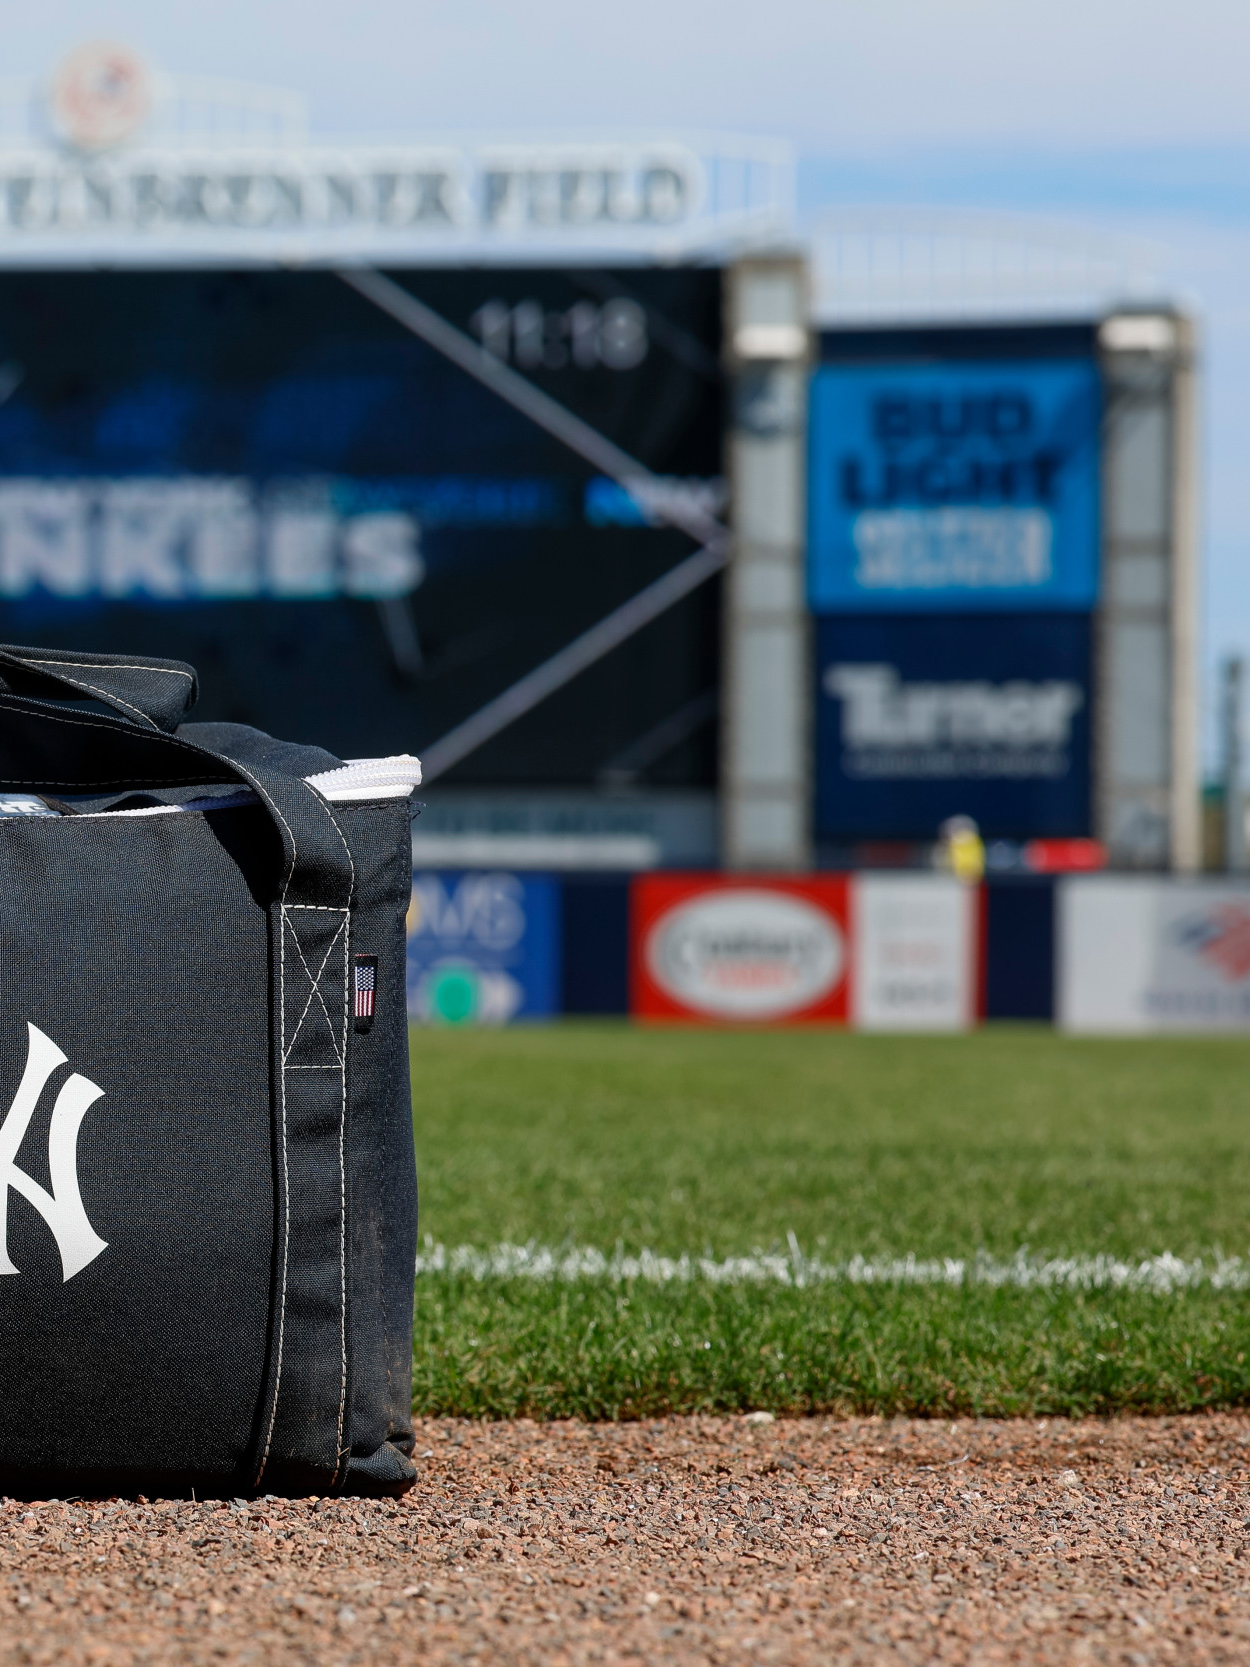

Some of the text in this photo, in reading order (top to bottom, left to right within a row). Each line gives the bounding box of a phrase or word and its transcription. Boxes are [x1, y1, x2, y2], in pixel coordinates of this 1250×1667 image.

[472, 145, 702, 228] FIELD
[870, 388, 1034, 440] BUD
[823, 662, 1084, 748] Turner
